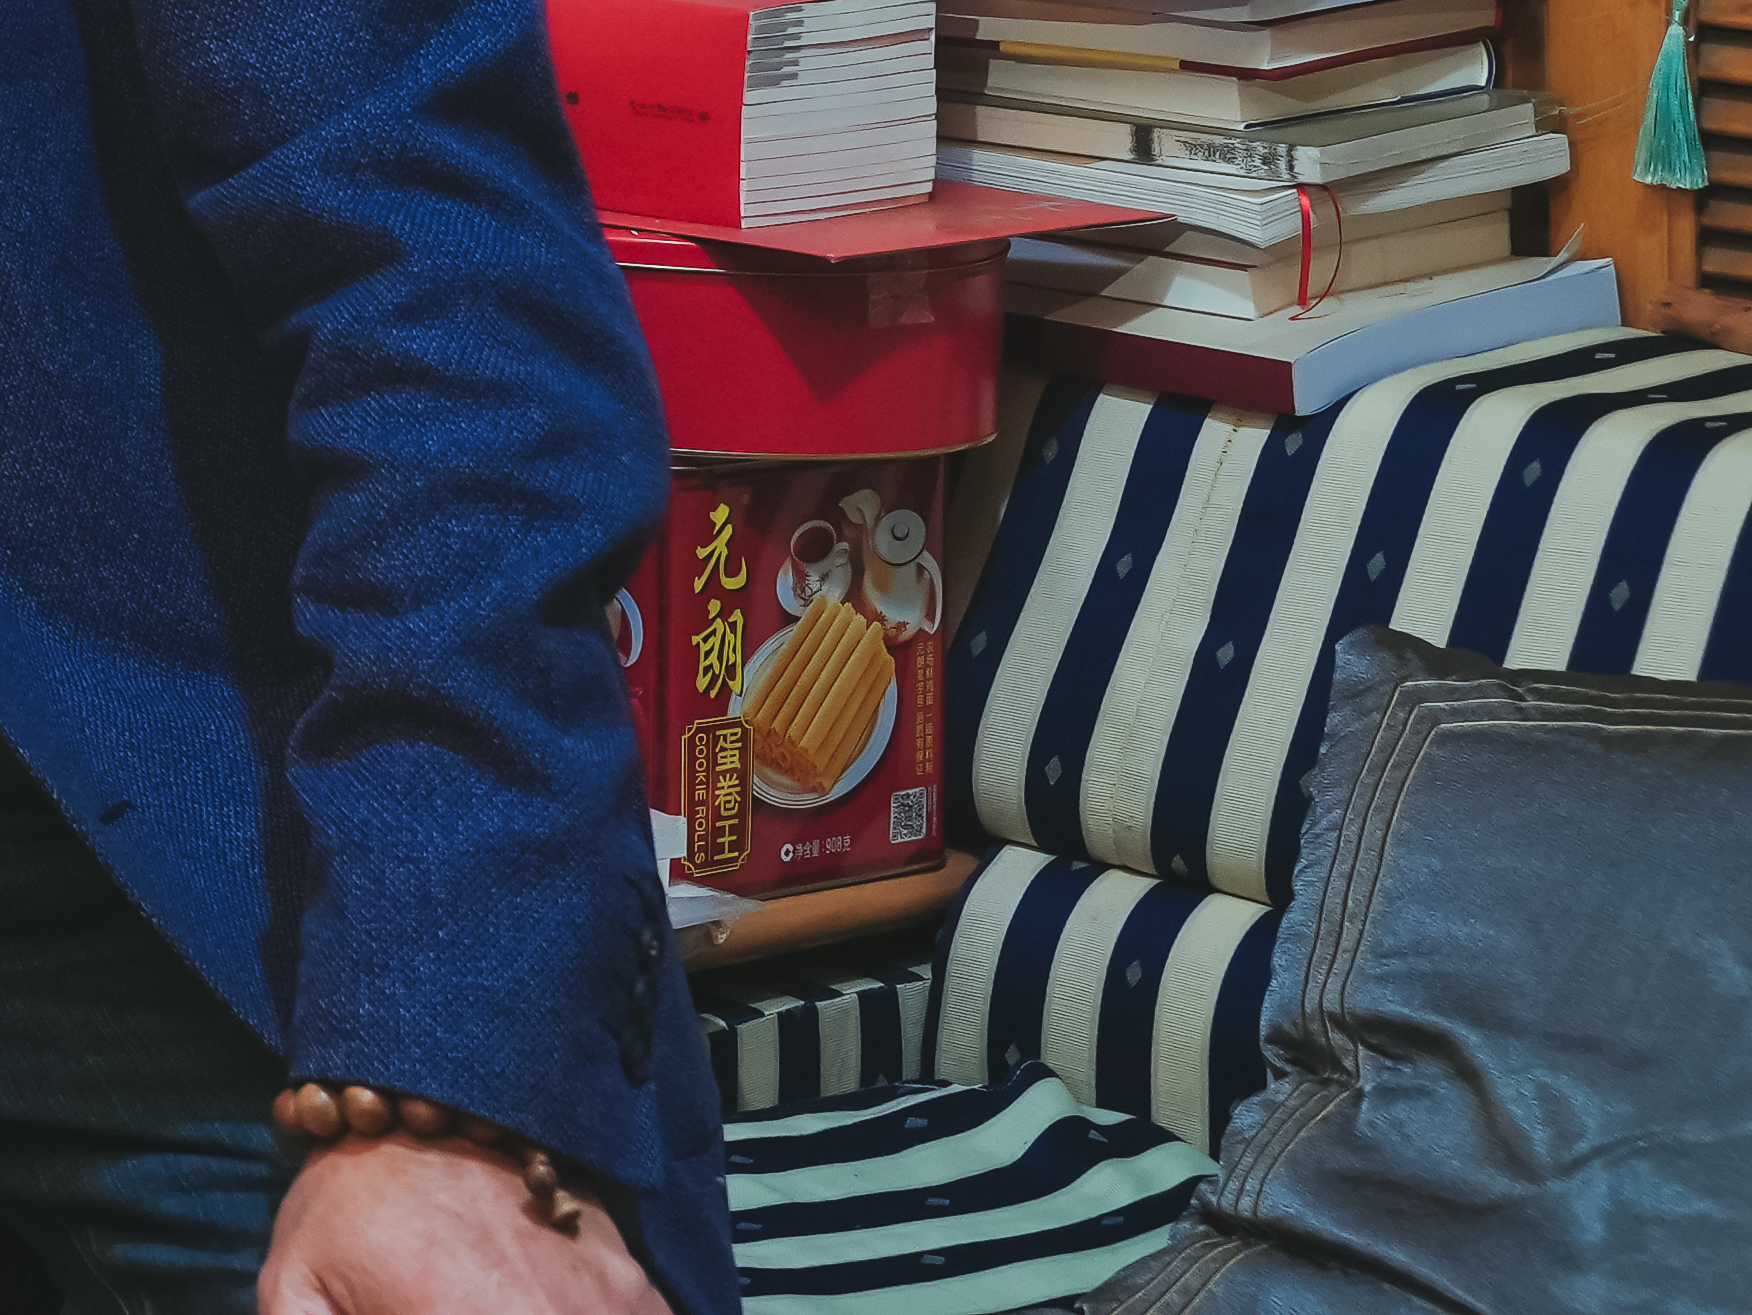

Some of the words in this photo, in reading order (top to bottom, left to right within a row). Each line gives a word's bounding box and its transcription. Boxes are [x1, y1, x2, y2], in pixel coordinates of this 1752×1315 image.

[692, 502, 747, 698] 元朗
[695, 733, 707, 802] COOKIE
[714, 727, 742, 861] 蛋卷王
[695, 808, 707, 864] ROLLS
